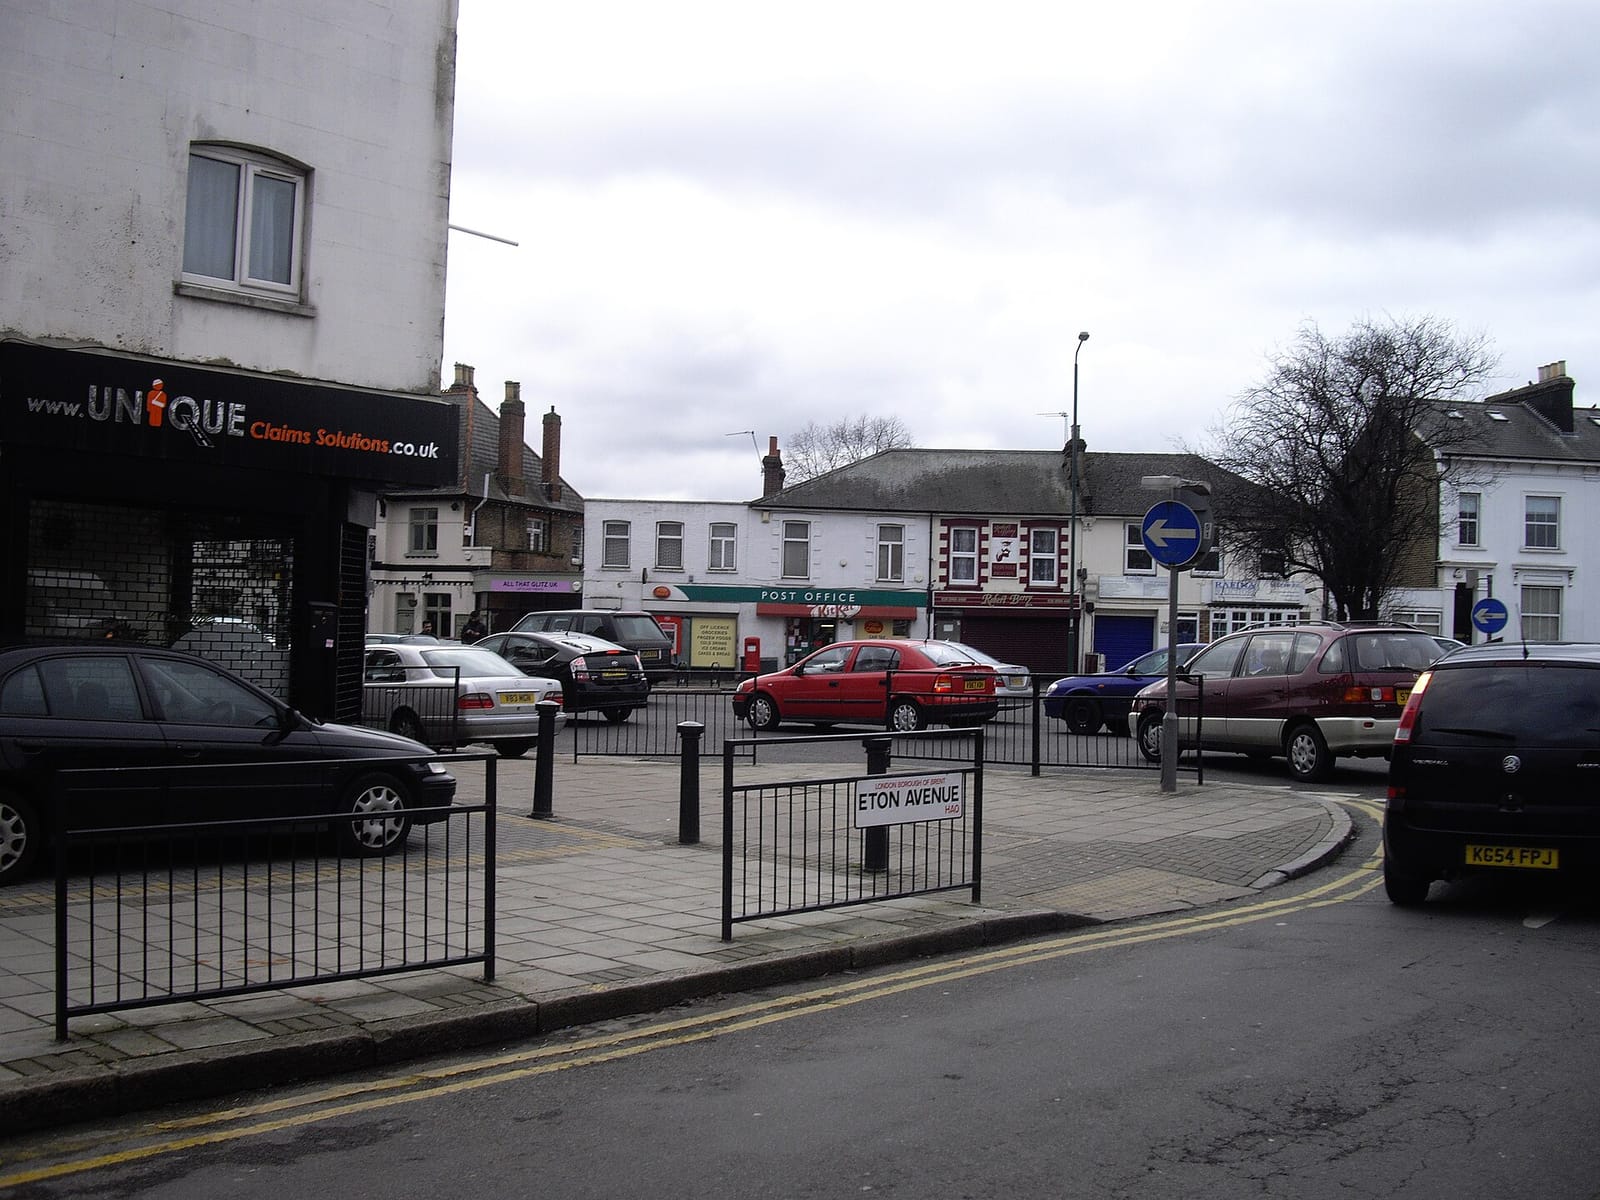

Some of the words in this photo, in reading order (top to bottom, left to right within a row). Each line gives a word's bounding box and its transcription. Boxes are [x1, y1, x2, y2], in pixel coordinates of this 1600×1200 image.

[250, 421, 311, 445] Claims
[761, 591, 797, 601] POST
[804, 592, 856, 602] OFFICE
[898, 780, 922, 788] BOROUGH
[930, 777, 946, 785] BRENT
[858, 790, 900, 811] ETON
[904, 785, 959, 807] AVENUE
[1472, 847, 1515, 864] KG54
[1519, 849, 1552, 866] FPJ
